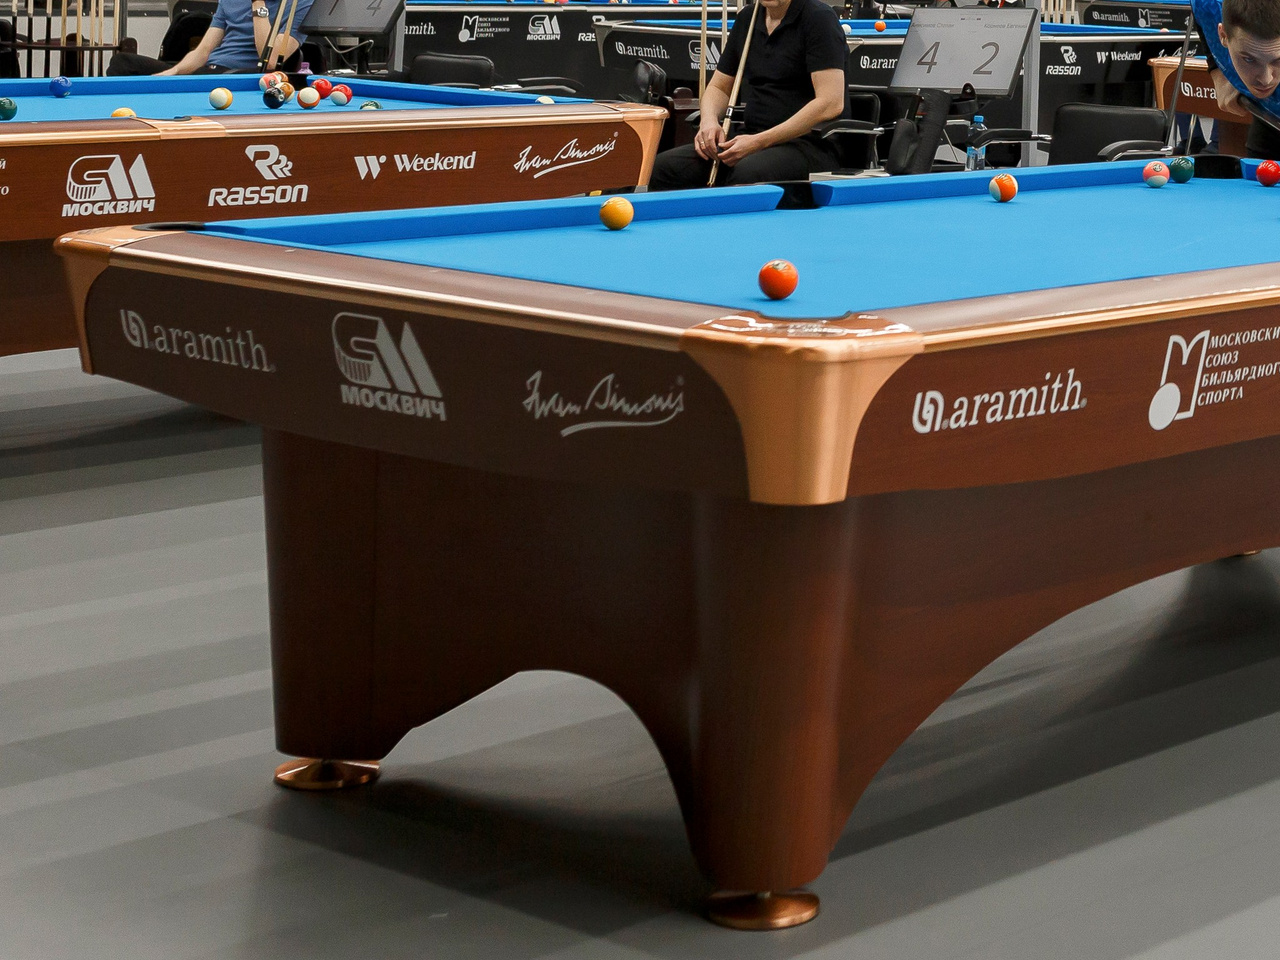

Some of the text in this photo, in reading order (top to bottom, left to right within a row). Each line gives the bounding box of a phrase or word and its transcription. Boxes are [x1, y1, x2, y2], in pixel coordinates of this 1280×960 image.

[1101, 12, 1129, 23] aramith
[526, 33, 560, 41] МОСКВИЧ
[627, 44, 668, 60] aramith
[916, 41, 1001, 75] 4 2
[1110, 50, 1142, 62] Weekend
[394, 151, 477, 173] Weekend
[61, 198, 156, 217] МОСКВИЧ
[153, 326, 272, 373] aramith
[1205, 350, 1239, 369] СОЮЗ
[339, 384, 448, 422] МОСКВИЧ
[948, 368, 1082, 431] aramith
[1198, 386, 1244, 408] СПОРТА
